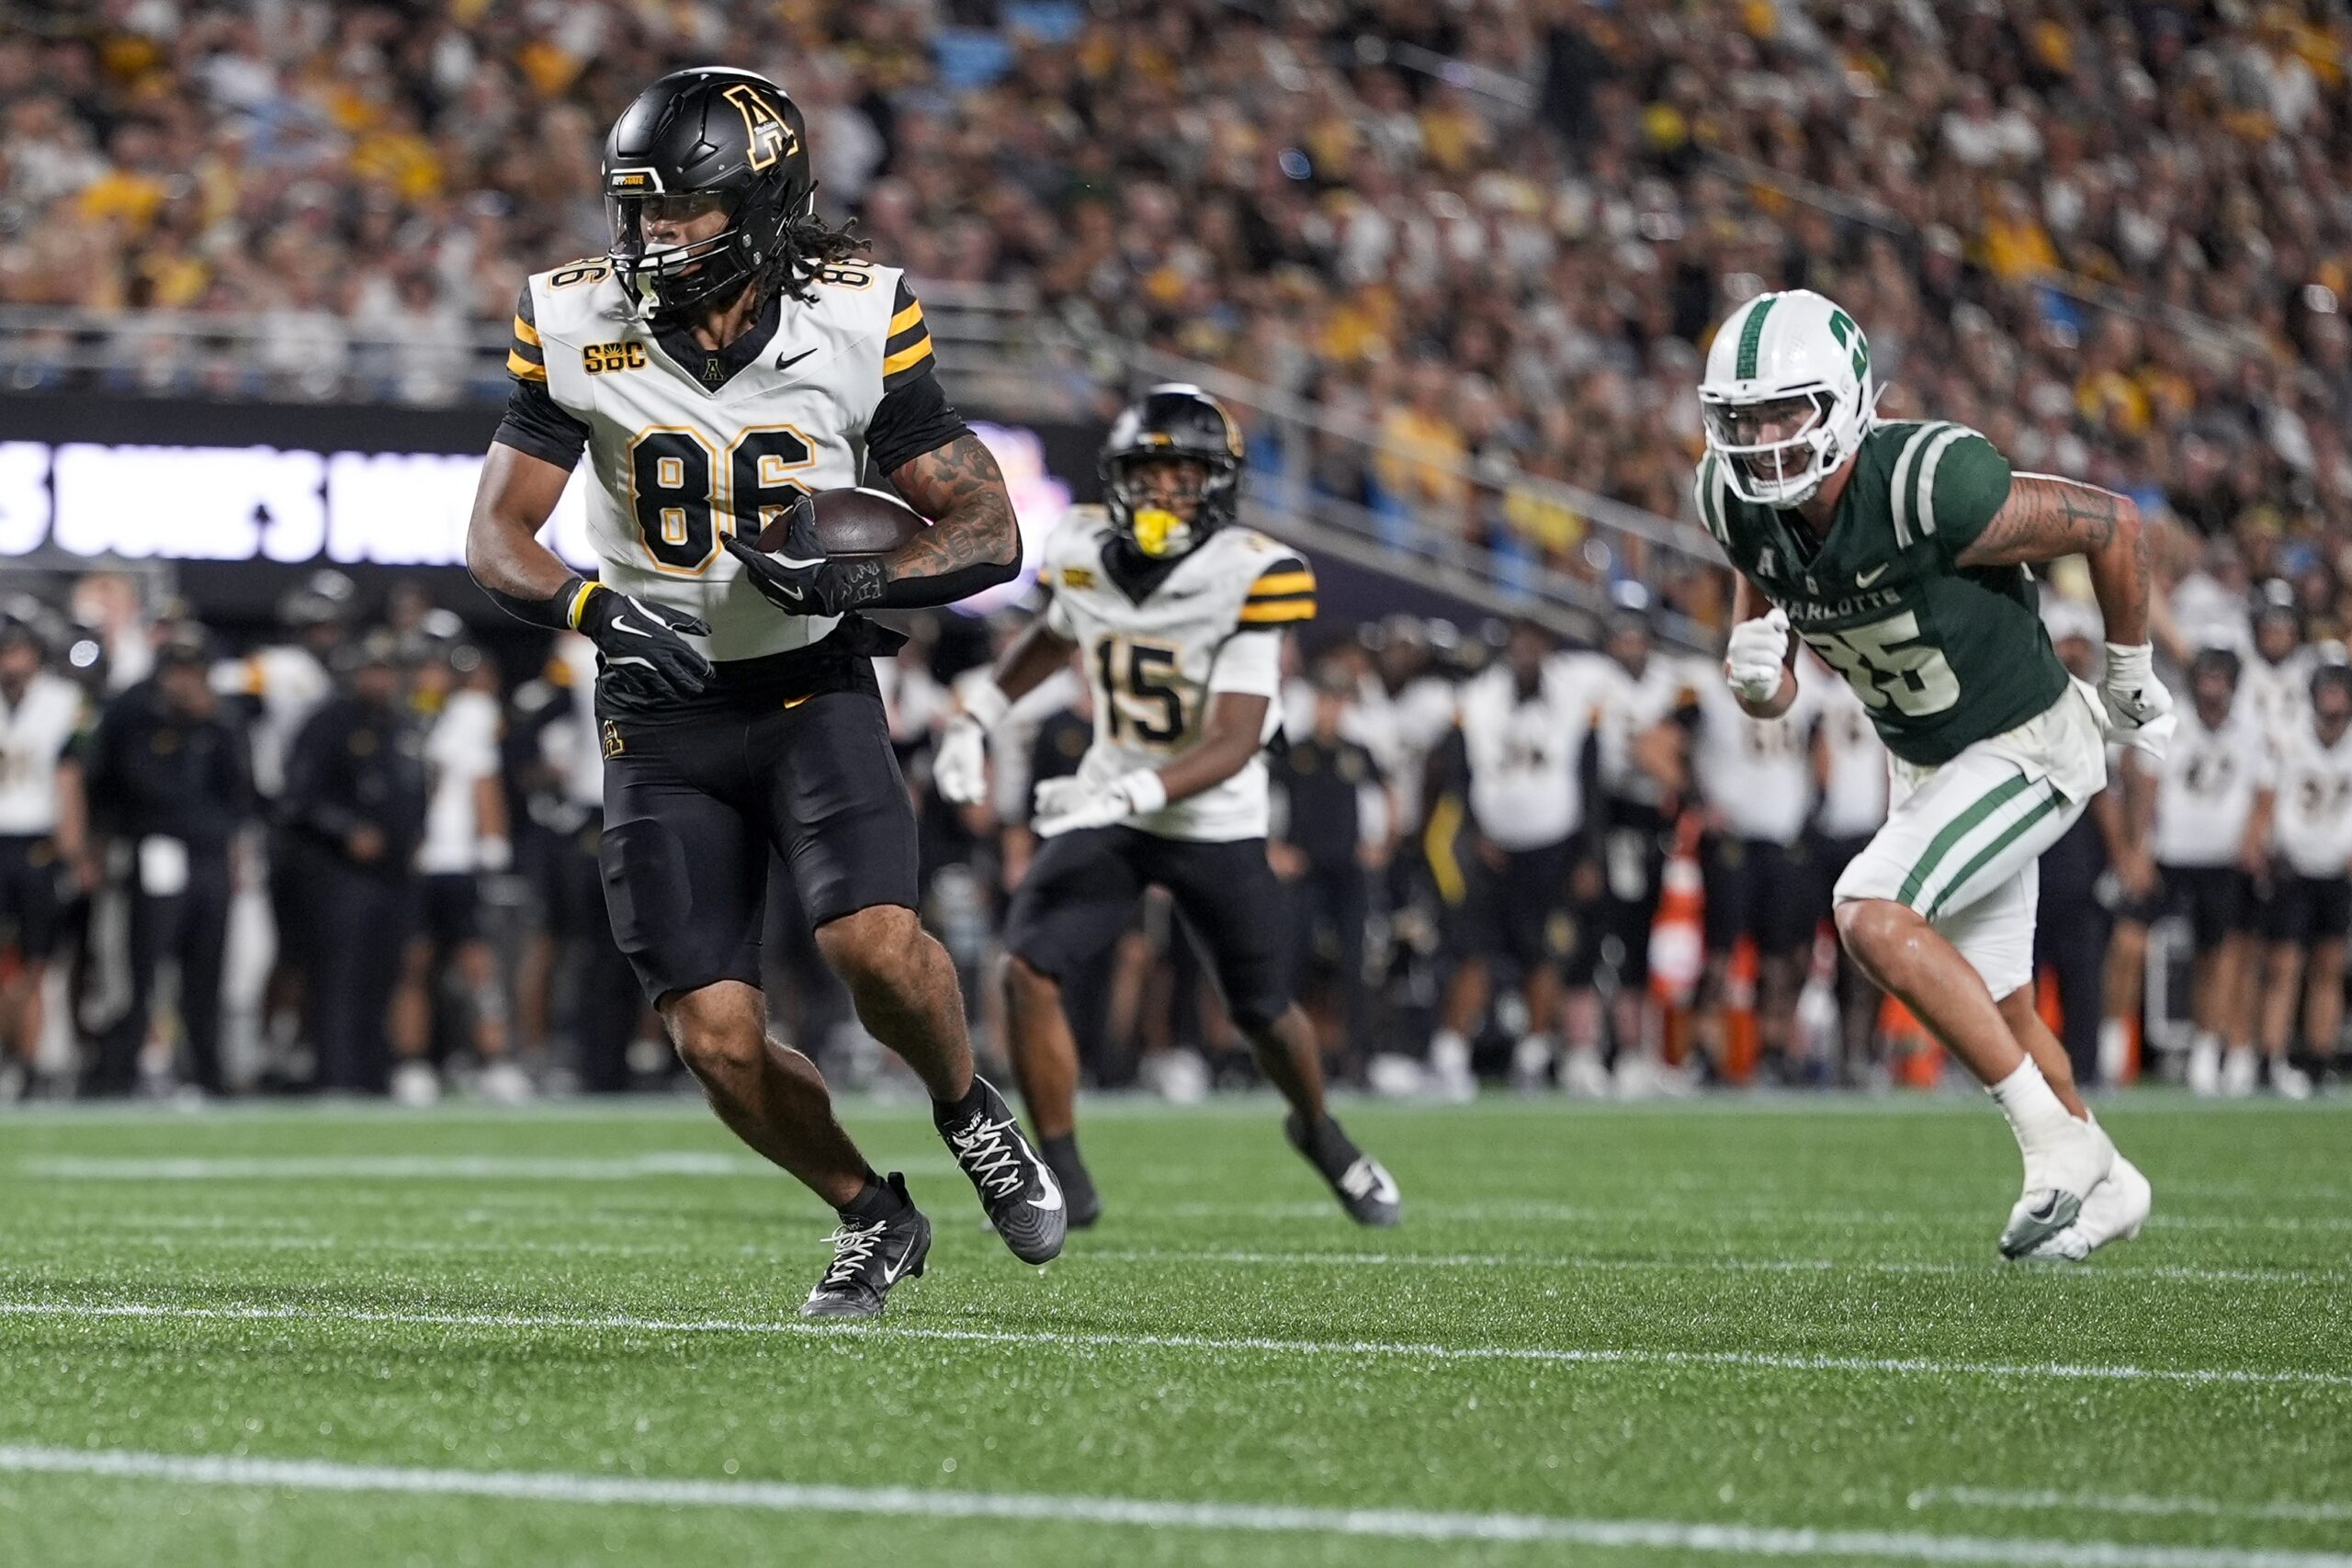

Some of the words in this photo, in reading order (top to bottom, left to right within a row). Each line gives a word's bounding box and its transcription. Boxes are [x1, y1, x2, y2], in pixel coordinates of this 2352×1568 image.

[722, 84, 798, 172] A
[582, 341, 647, 375] SBC
[703, 358, 724, 381] A
[628, 423, 817, 578] 86
[1770, 587, 1902, 621] HARLOTTE
[1095, 633, 1187, 750] 15
